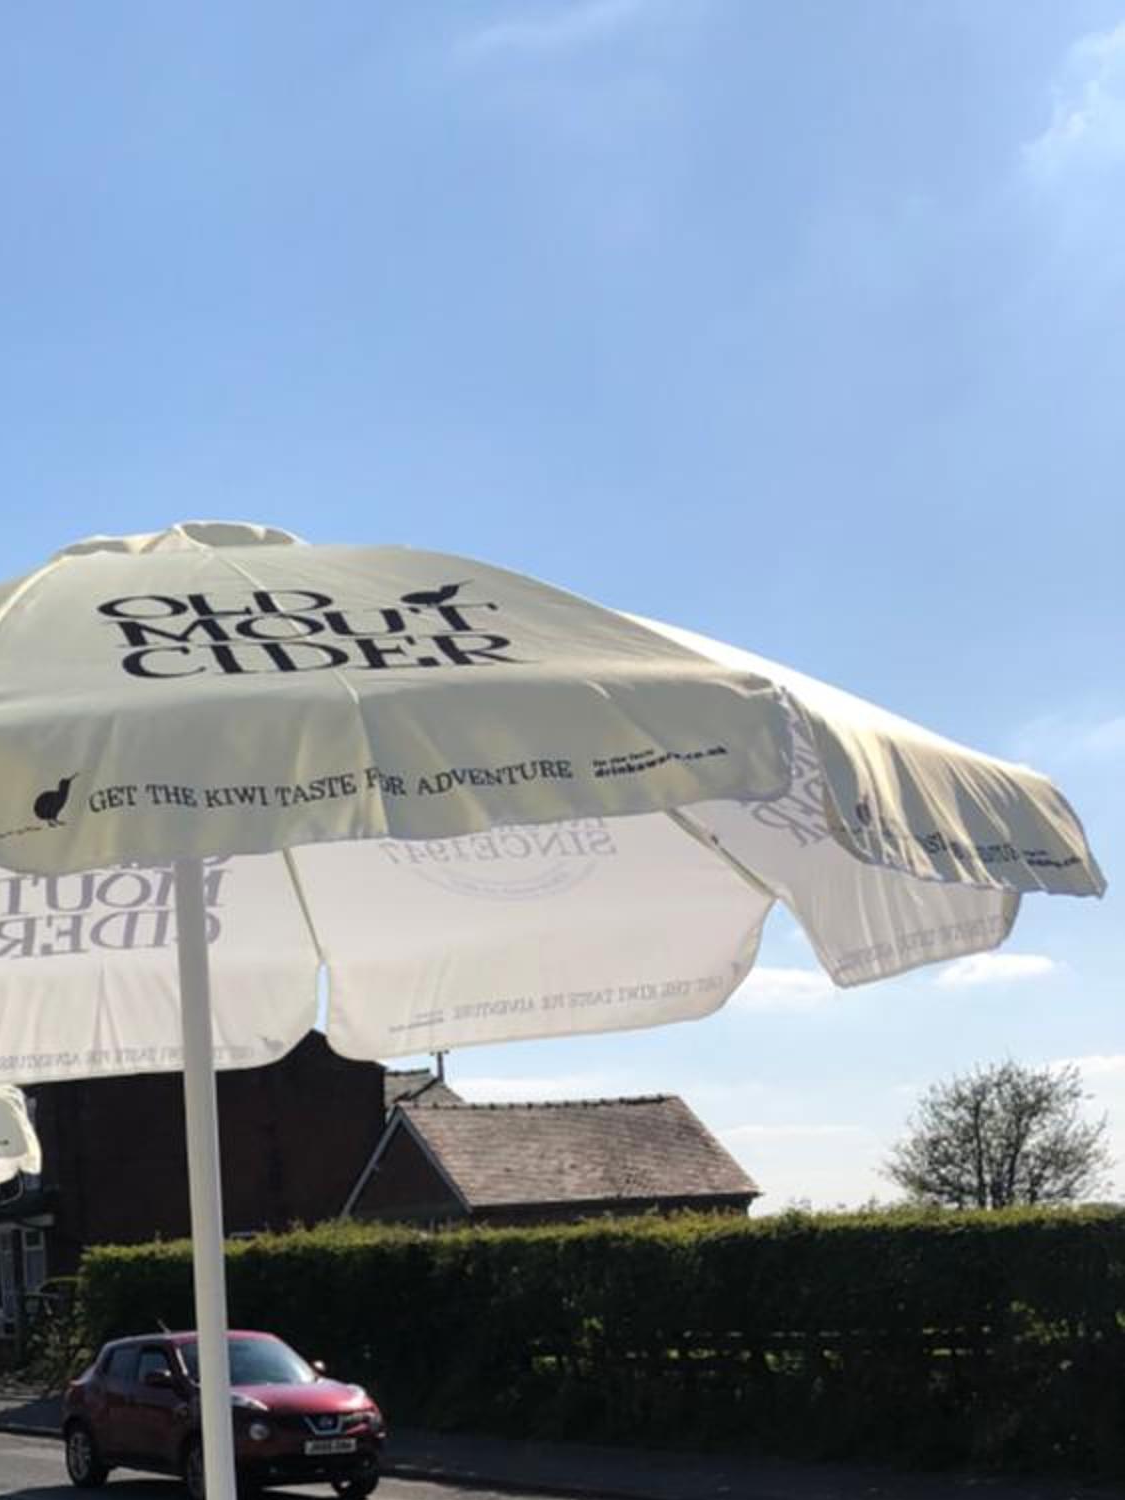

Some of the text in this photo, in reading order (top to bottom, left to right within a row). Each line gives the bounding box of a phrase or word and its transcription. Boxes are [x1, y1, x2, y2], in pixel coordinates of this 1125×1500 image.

[97, 589, 333, 619] OLD
[103, 602, 498, 647] MOUT
[121, 634, 536, 678] CIDER
[88, 759, 573, 813] GET THE KIWI TASTE FOR ADVENTURE
